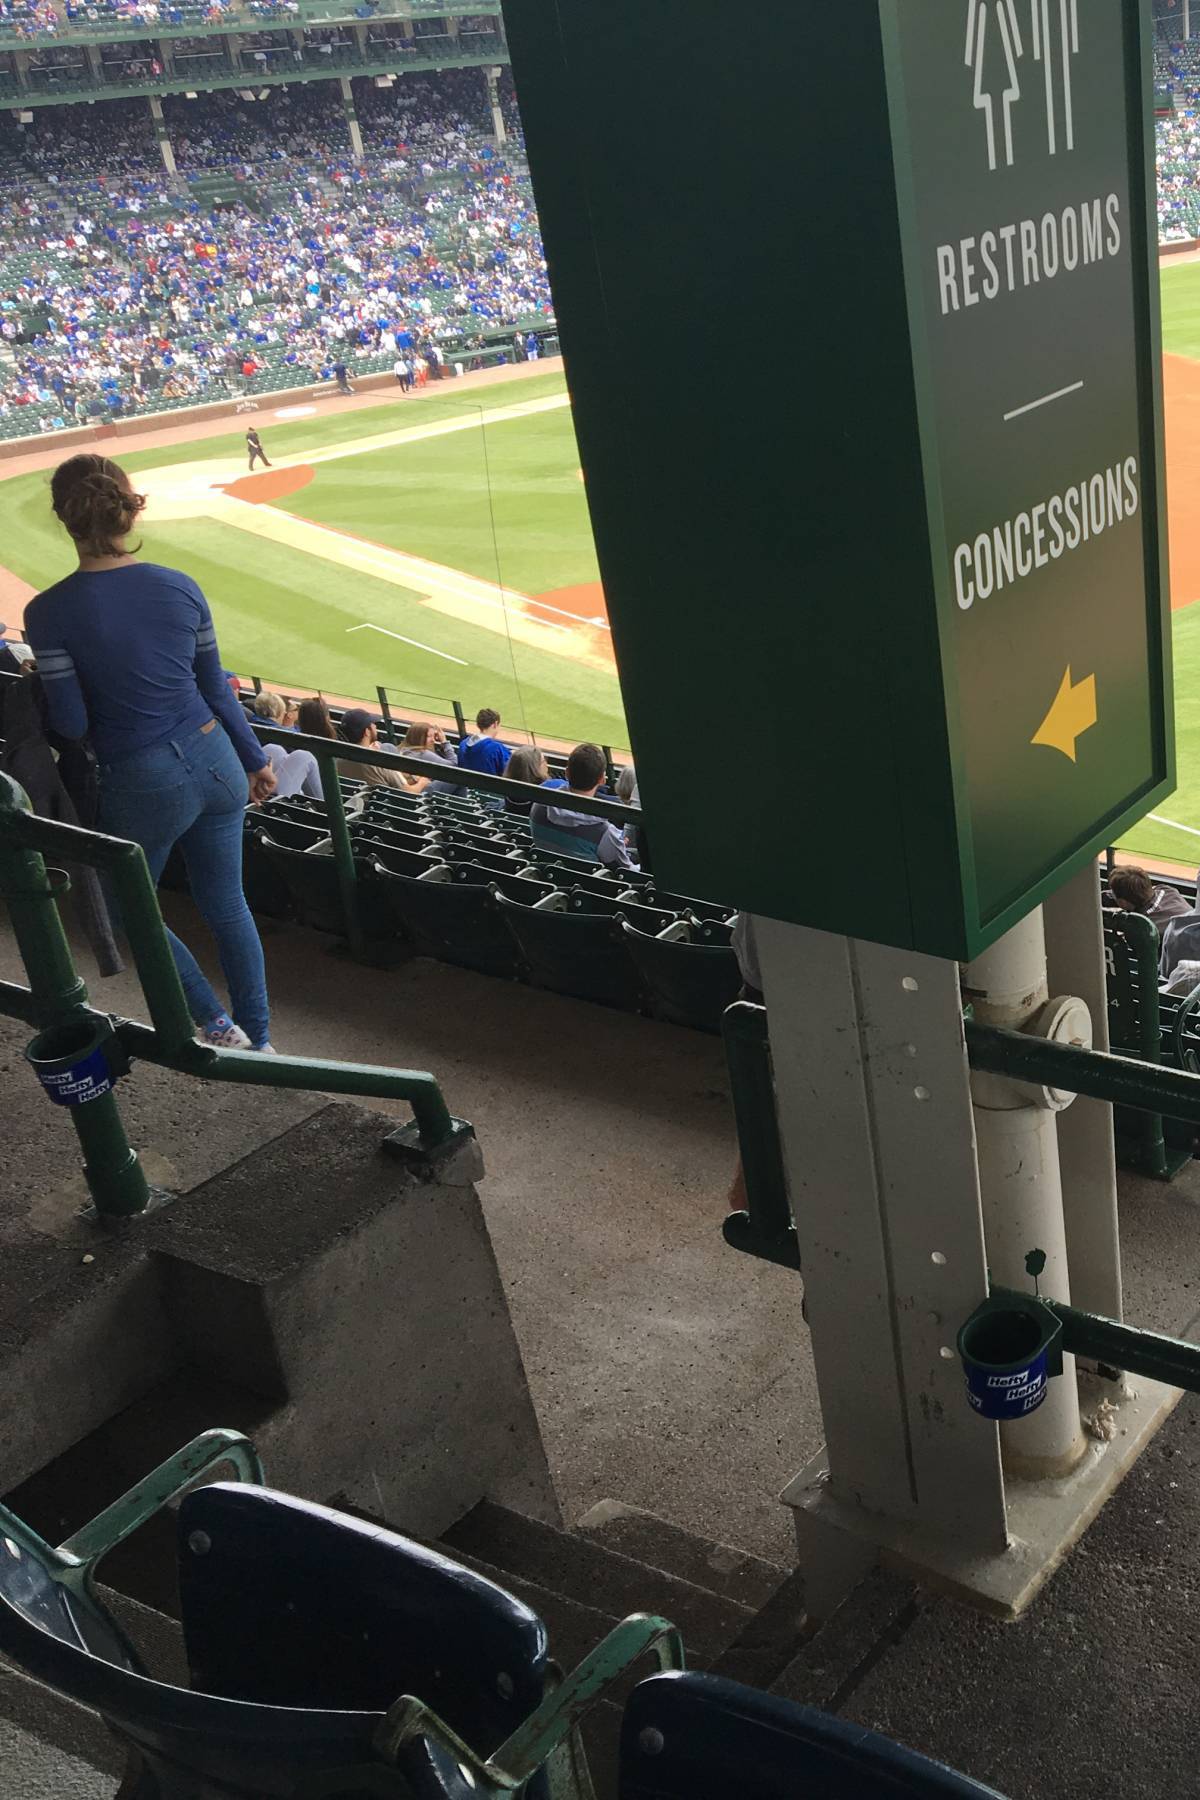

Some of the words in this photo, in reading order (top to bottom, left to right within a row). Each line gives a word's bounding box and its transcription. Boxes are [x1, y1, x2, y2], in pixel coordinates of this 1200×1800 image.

[937, 193, 1121, 315] RESTROOMS
[954, 455, 1139, 610] CONCESSIONS
[61, 1078, 93, 1094] Hefty
[988, 1371, 1028, 1387] Hefty
[1007, 1375, 1042, 1400] Hefty
